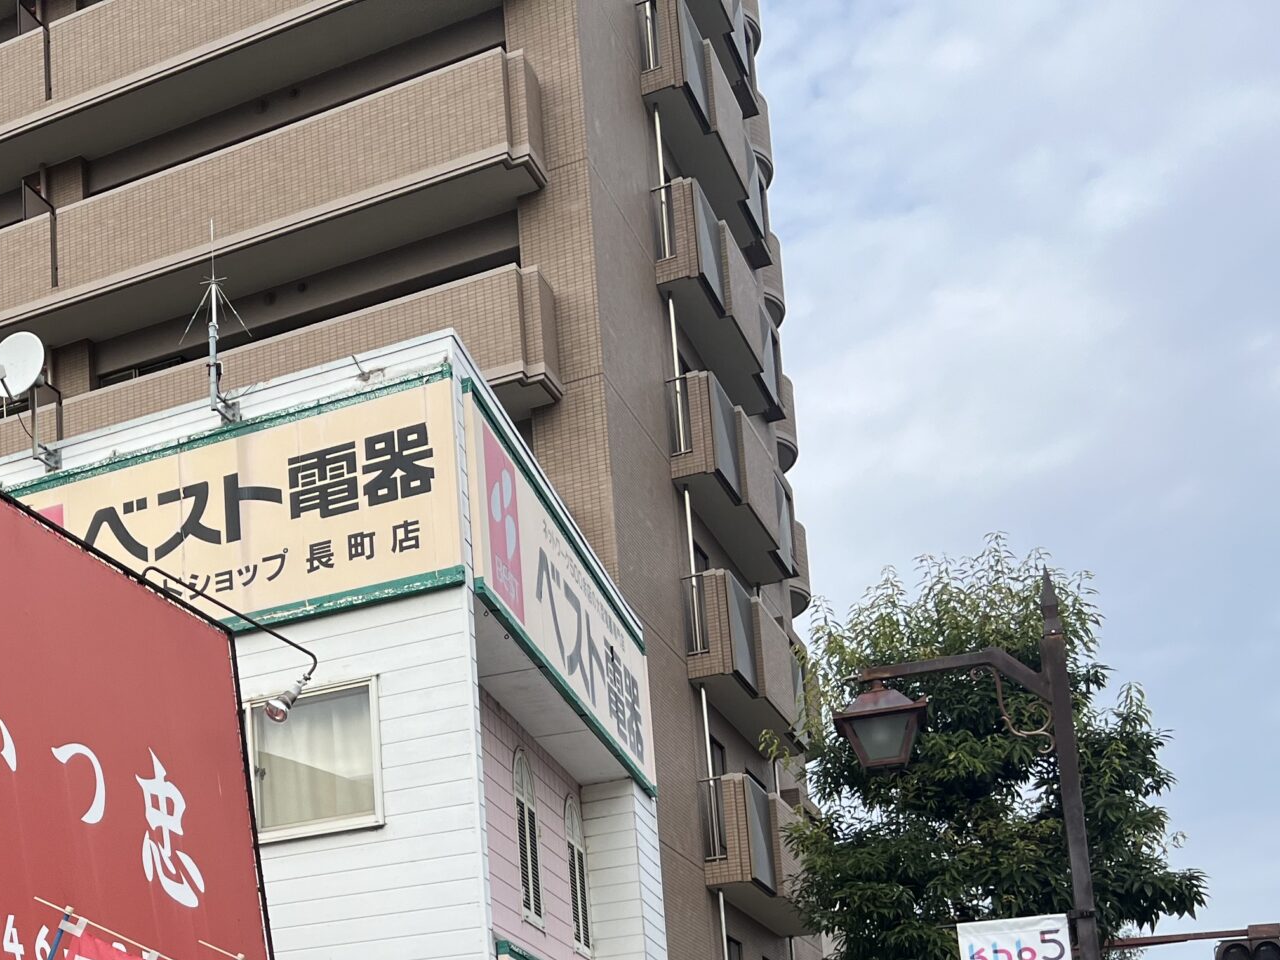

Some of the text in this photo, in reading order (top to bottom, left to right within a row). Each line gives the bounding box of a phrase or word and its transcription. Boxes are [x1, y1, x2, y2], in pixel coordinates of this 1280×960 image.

[84, 422, 435, 563] ベスト電器
[306, 520, 421, 573] 長町店
[535, 547, 644, 765] ベスト電器
